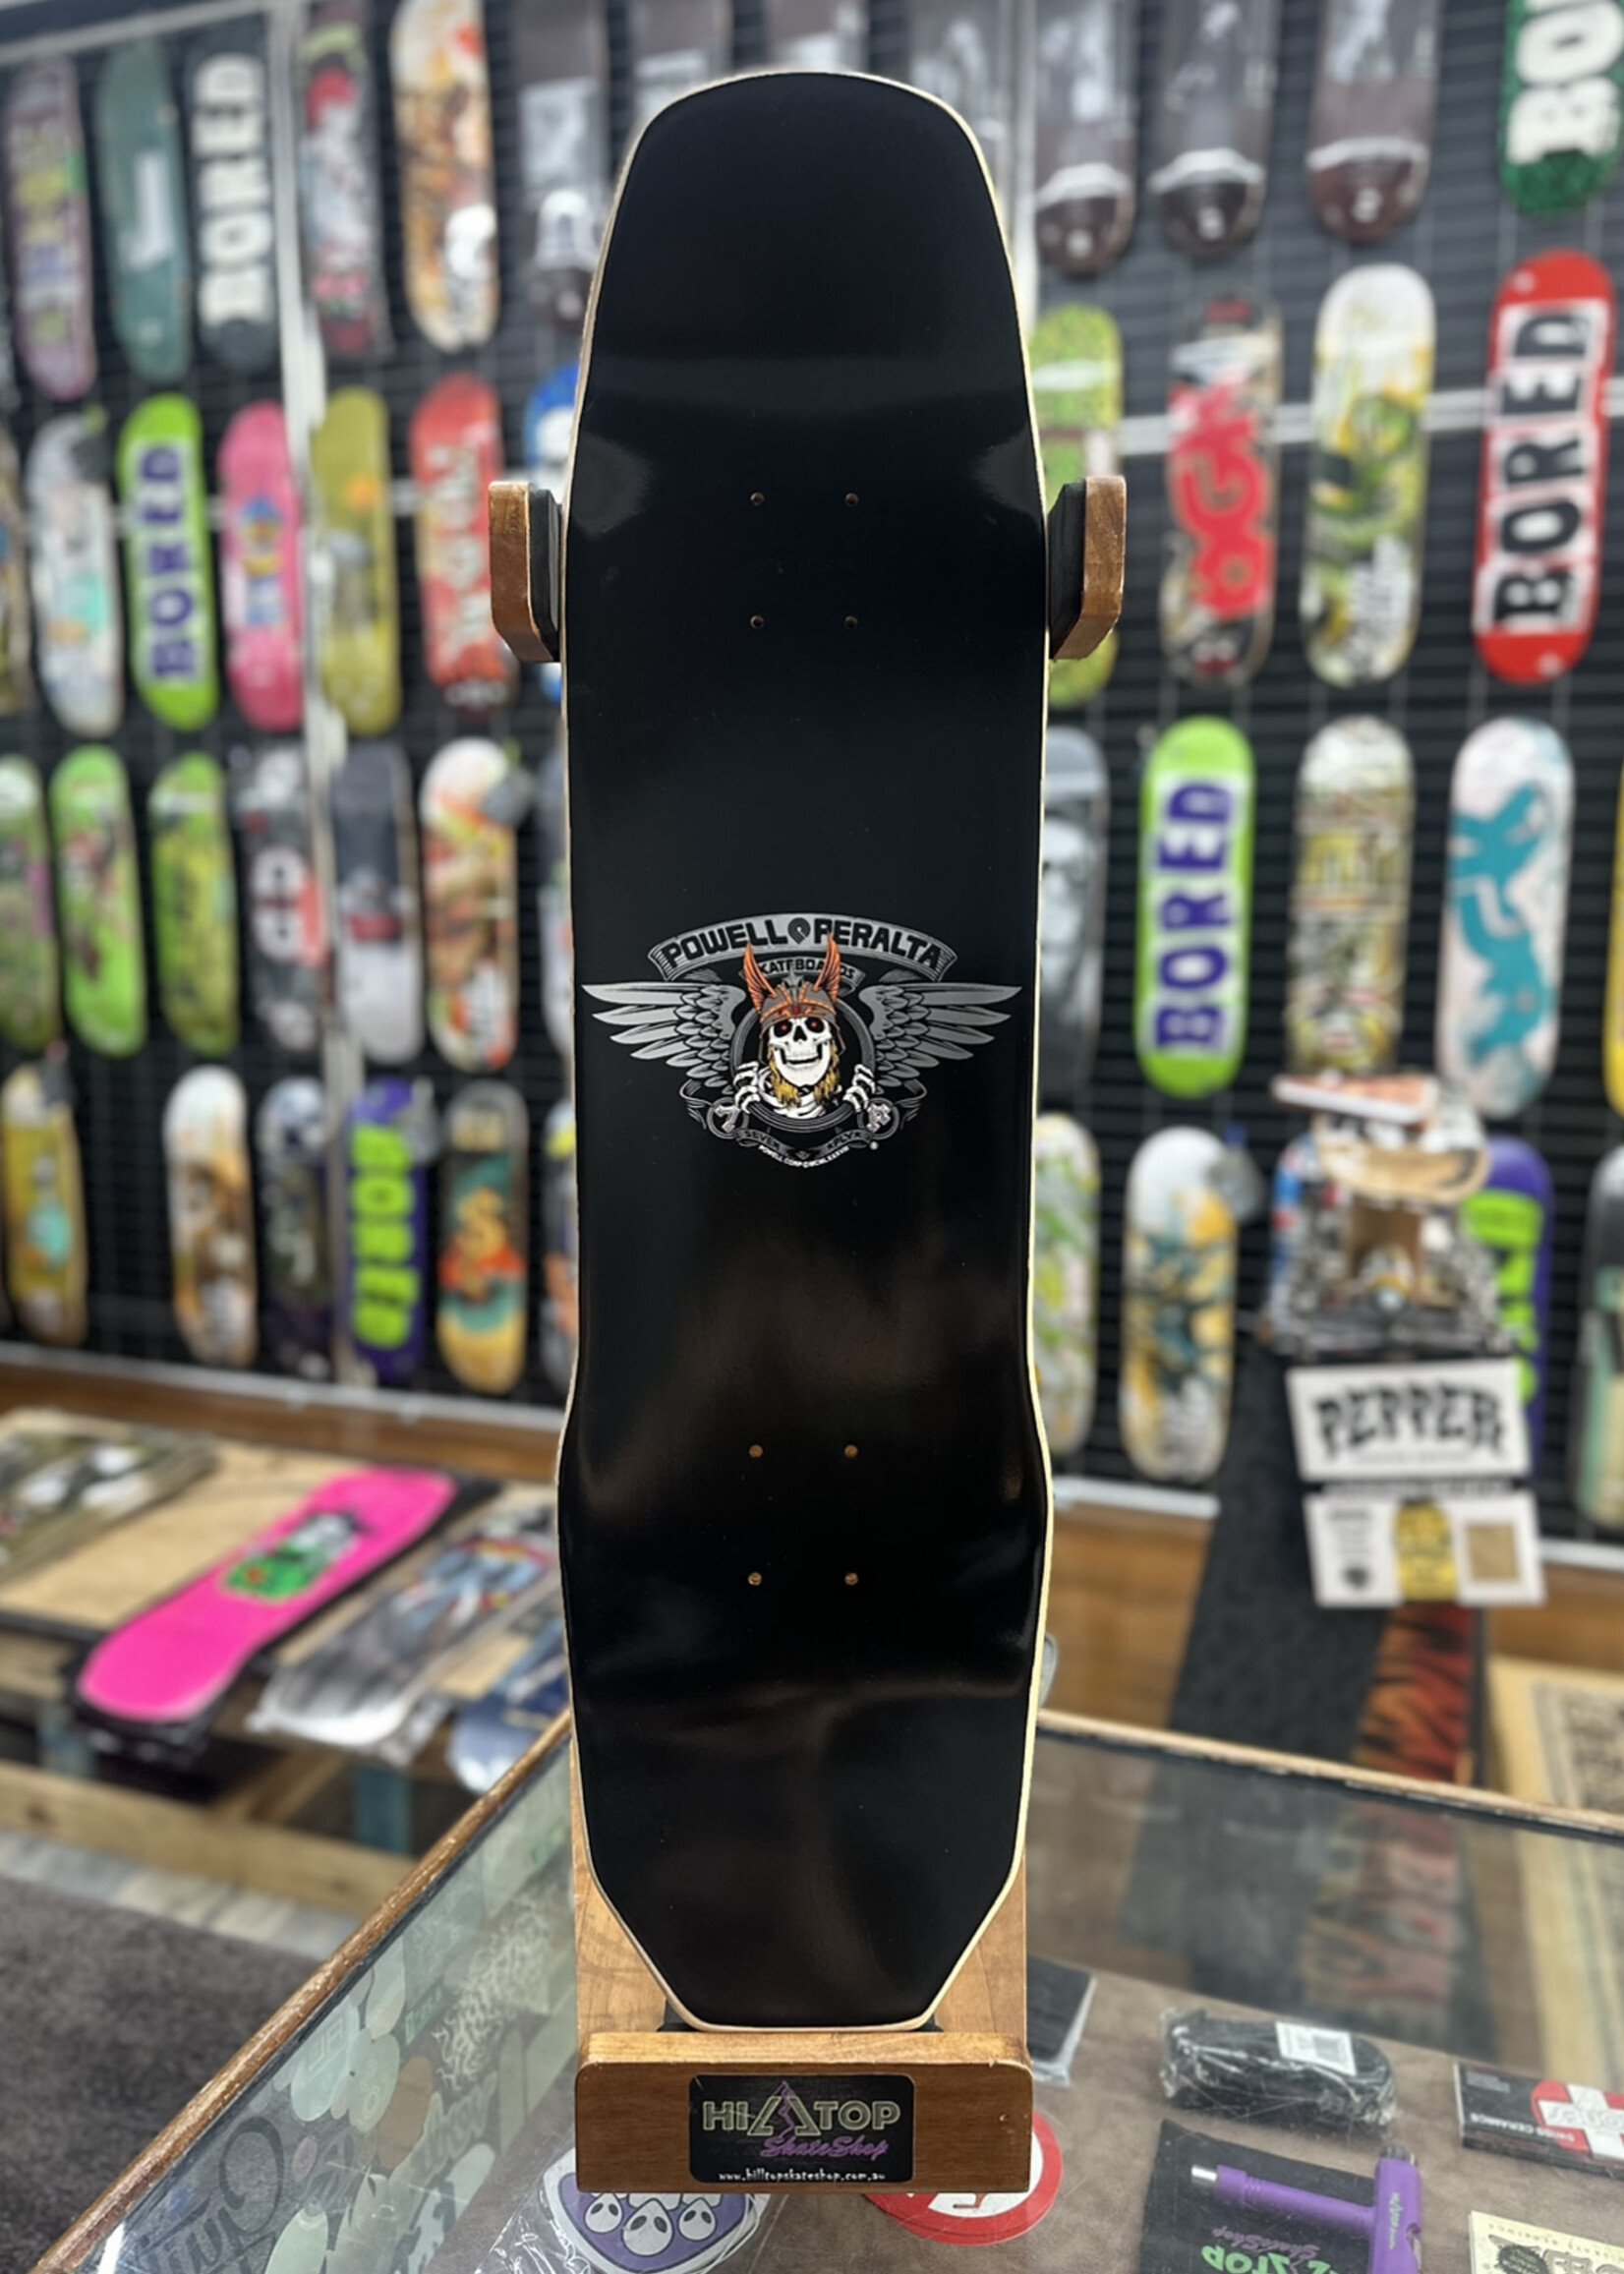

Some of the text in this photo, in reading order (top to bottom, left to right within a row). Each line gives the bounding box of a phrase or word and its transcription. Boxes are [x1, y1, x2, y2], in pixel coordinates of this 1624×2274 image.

[1492, 314, 1589, 631] BORED
[142, 445, 197, 681] BORED
[662, 918, 942, 969] POWELL PERALTA
[1154, 781, 1238, 1051] BORED
[1312, 1378, 1505, 1463] PEPPER
[718, 2167, 887, 2184] www.hilltopskateshop.com.au
